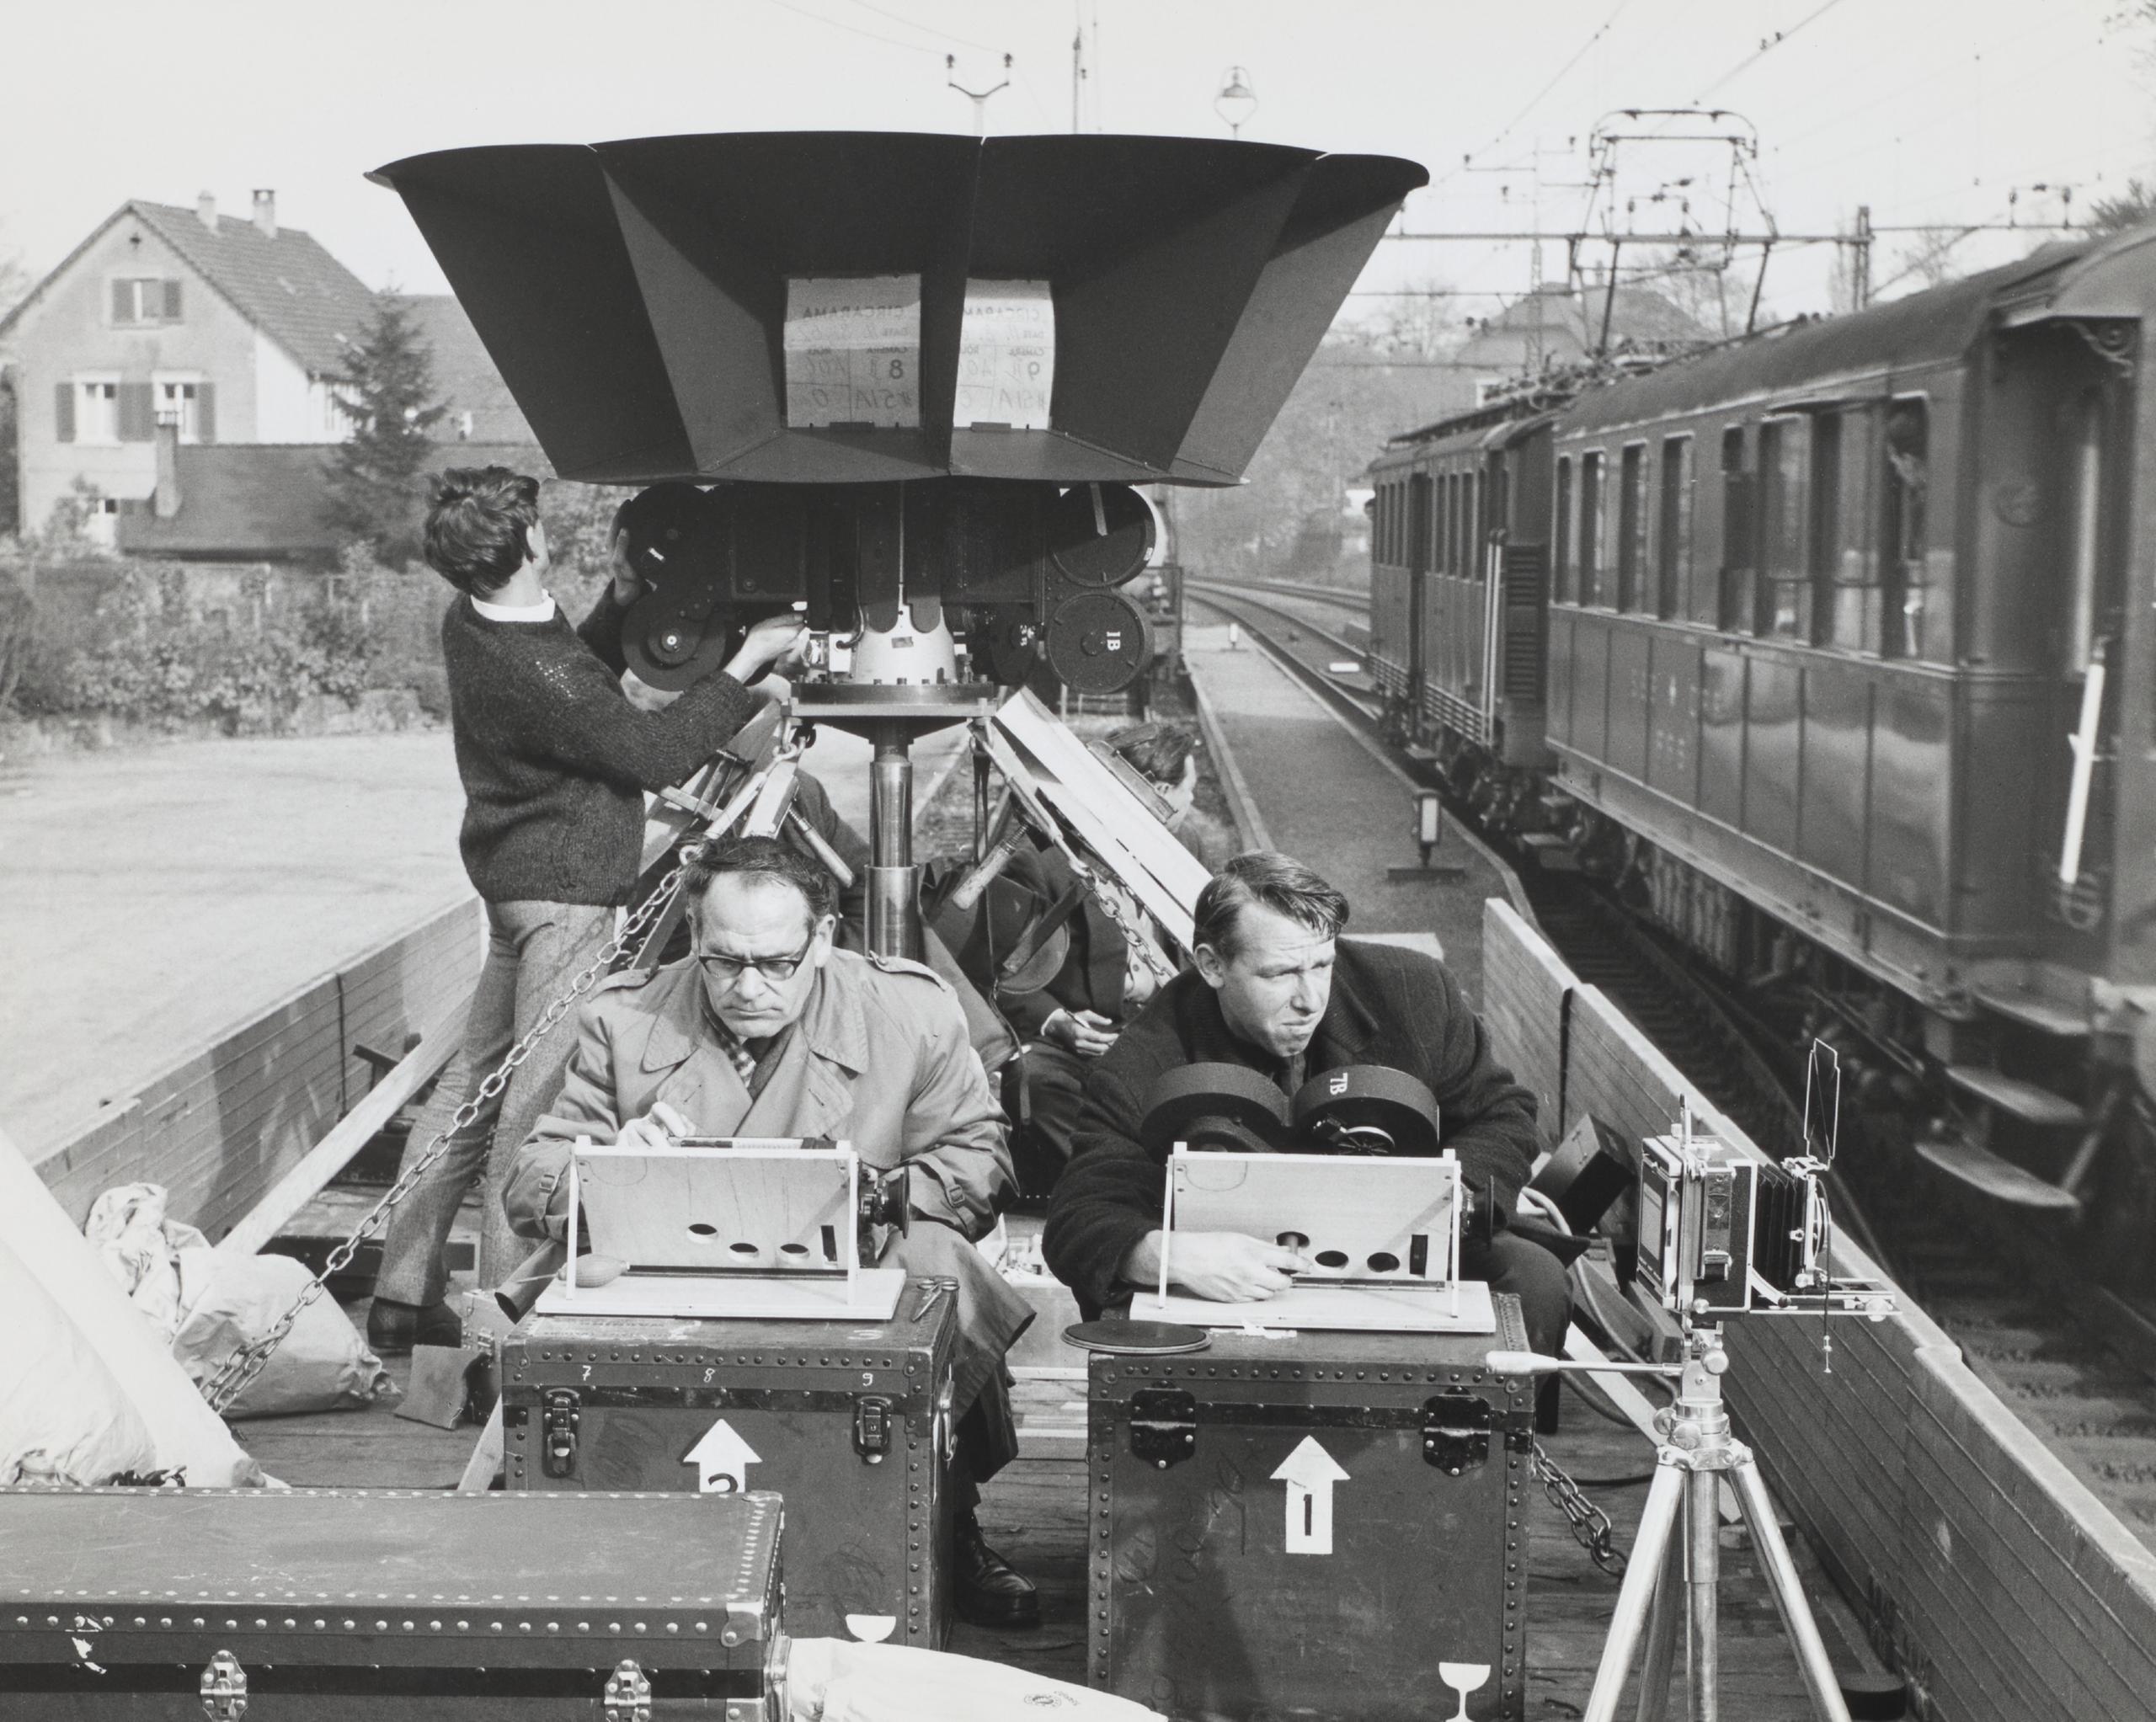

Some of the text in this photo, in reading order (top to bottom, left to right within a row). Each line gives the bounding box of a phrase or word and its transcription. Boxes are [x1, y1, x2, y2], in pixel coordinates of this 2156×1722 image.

[1106, 631, 1121, 651] 1B
[1330, 1072, 1348, 1095] 7B
[582, 1364, 874, 1387] 7 8 9
[1303, 1494, 1312, 1536] 1
